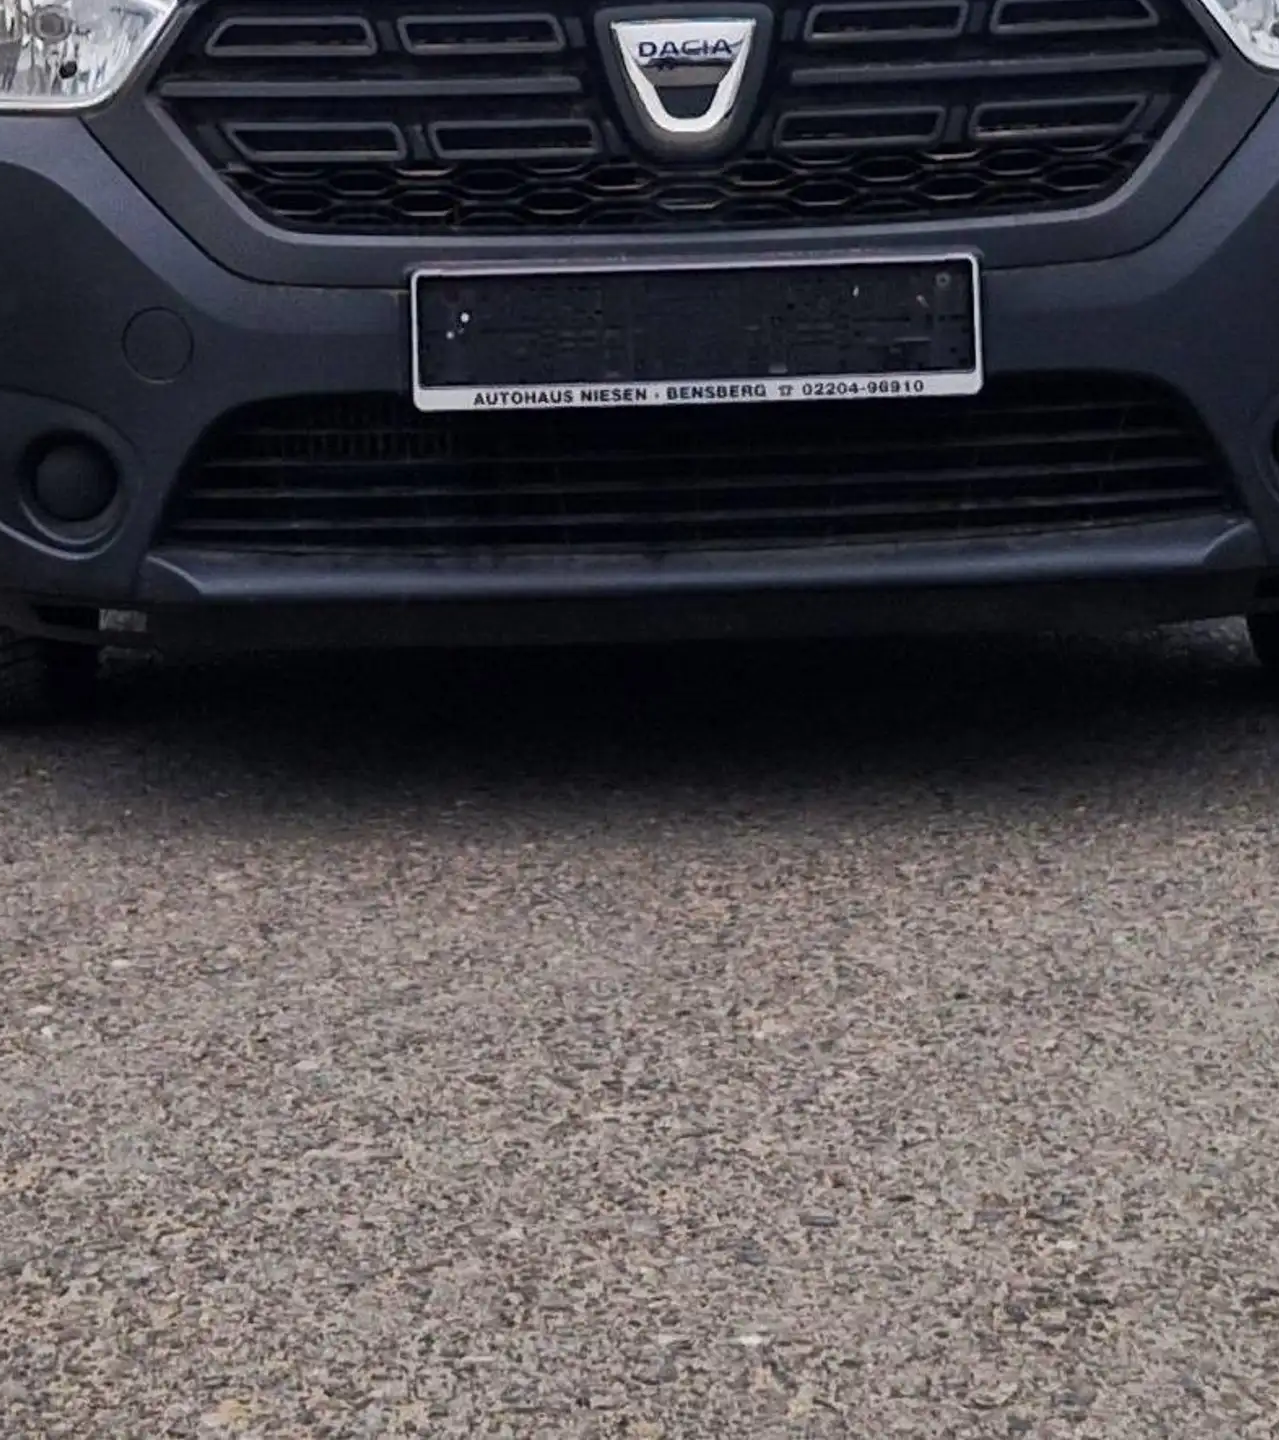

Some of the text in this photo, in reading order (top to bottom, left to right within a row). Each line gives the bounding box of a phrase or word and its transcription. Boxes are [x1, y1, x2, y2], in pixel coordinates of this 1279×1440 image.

[638, 38, 734, 58] DACIA
[473, 390, 574, 406] AUTOHAUS
[580, 387, 647, 403] NIESEN
[666, 383, 767, 400] BENSBERG
